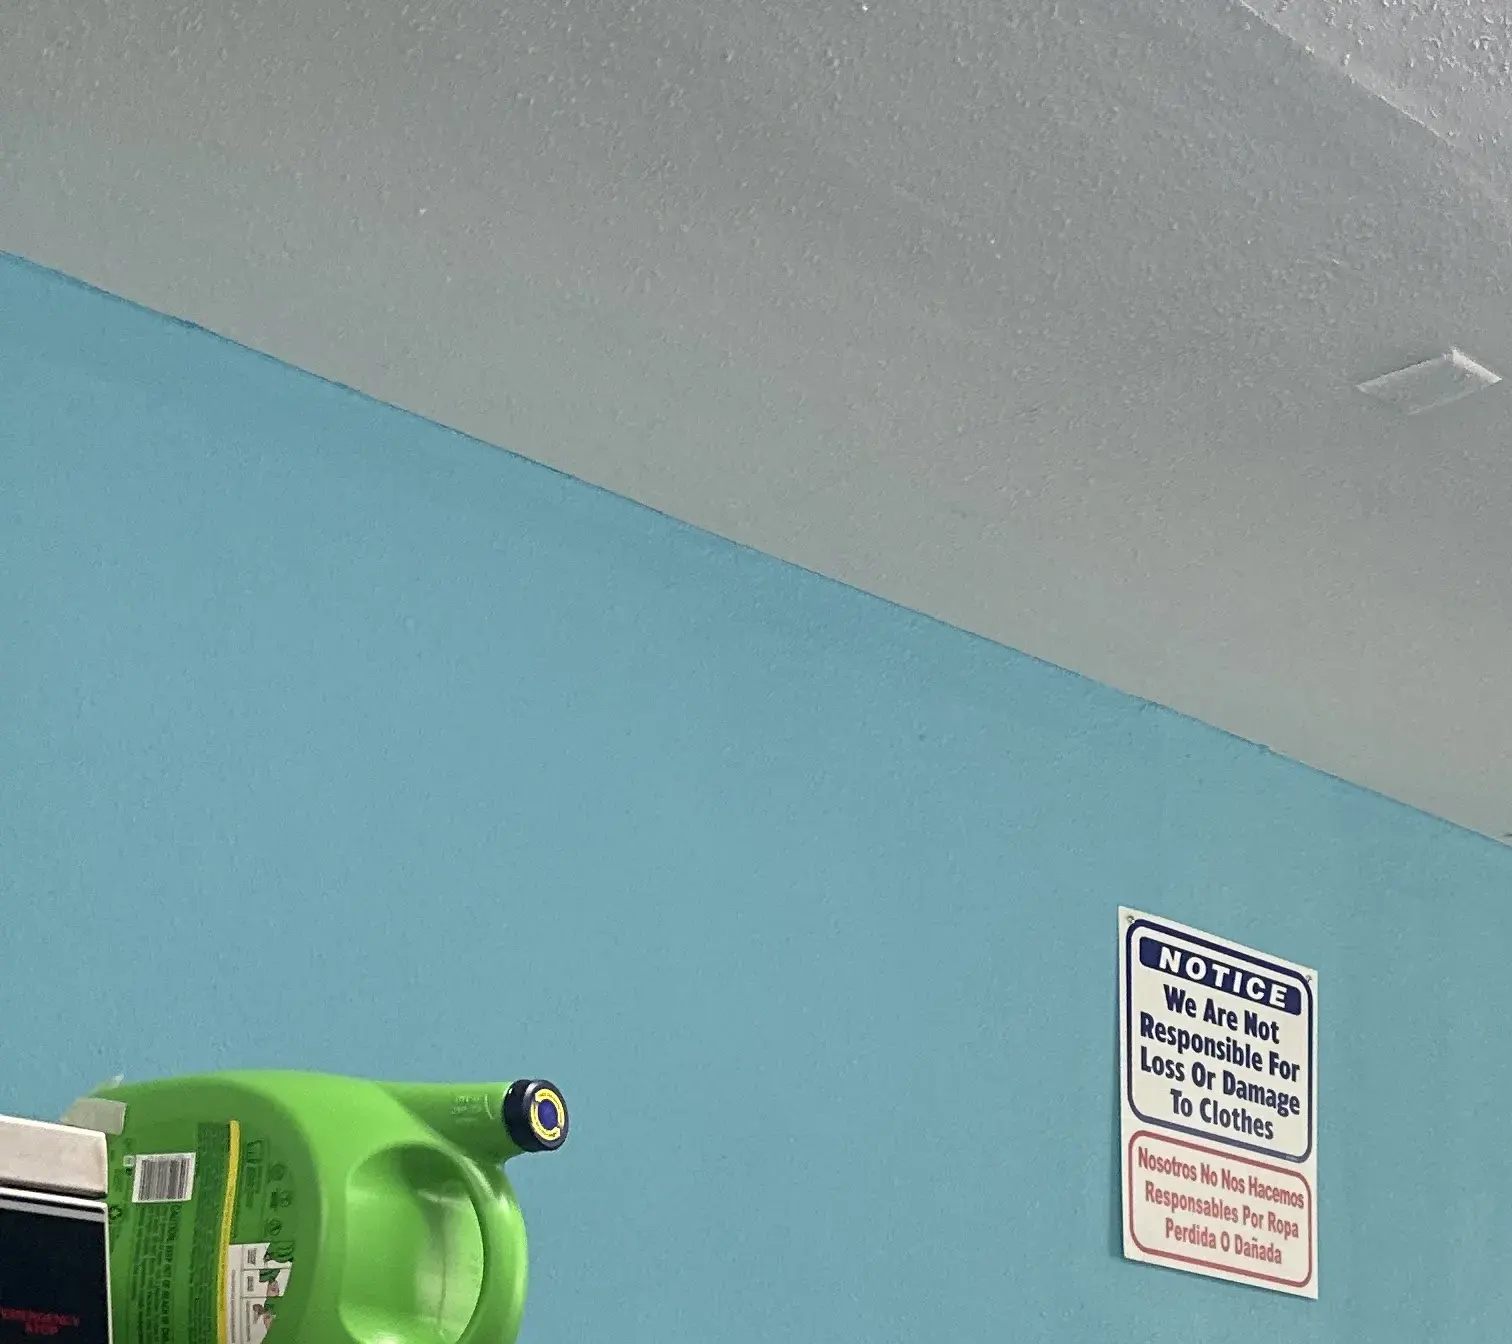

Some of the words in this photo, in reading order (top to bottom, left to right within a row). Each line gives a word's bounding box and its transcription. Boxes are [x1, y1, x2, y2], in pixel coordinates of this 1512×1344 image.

[1159, 947, 1287, 1007] NOTICE
[1163, 984, 1196, 1017] We
[1203, 998, 1238, 1031] Are
[1244, 1010, 1280, 1044] Not
[1140, 1011, 1263, 1071] Responsible
[1269, 1050, 1300, 1082] For
[1140, 1046, 1185, 1081] Loss
[1191, 1061, 1216, 1090] Or
[1223, 1070, 1300, 1117] Damage
[1170, 1088, 1193, 1117] To
[1200, 1098, 1273, 1140] Clothes
[1138, 1146, 1197, 1181] Nosotros
[1200, 1162, 1218, 1187] No
[1221, 1168, 1245, 1194] Nos
[1249, 1176, 1304, 1209] Hacemos
[1145, 1180, 1238, 1223] Responsables
[1243, 1205, 1264, 1229] Por
[1268, 1211, 1299, 1240] Ropa
[1165, 1218, 1216, 1249] Perdida
[1220, 1231, 1230, 1252] O
[1235, 1234, 1282, 1264] Dañada
